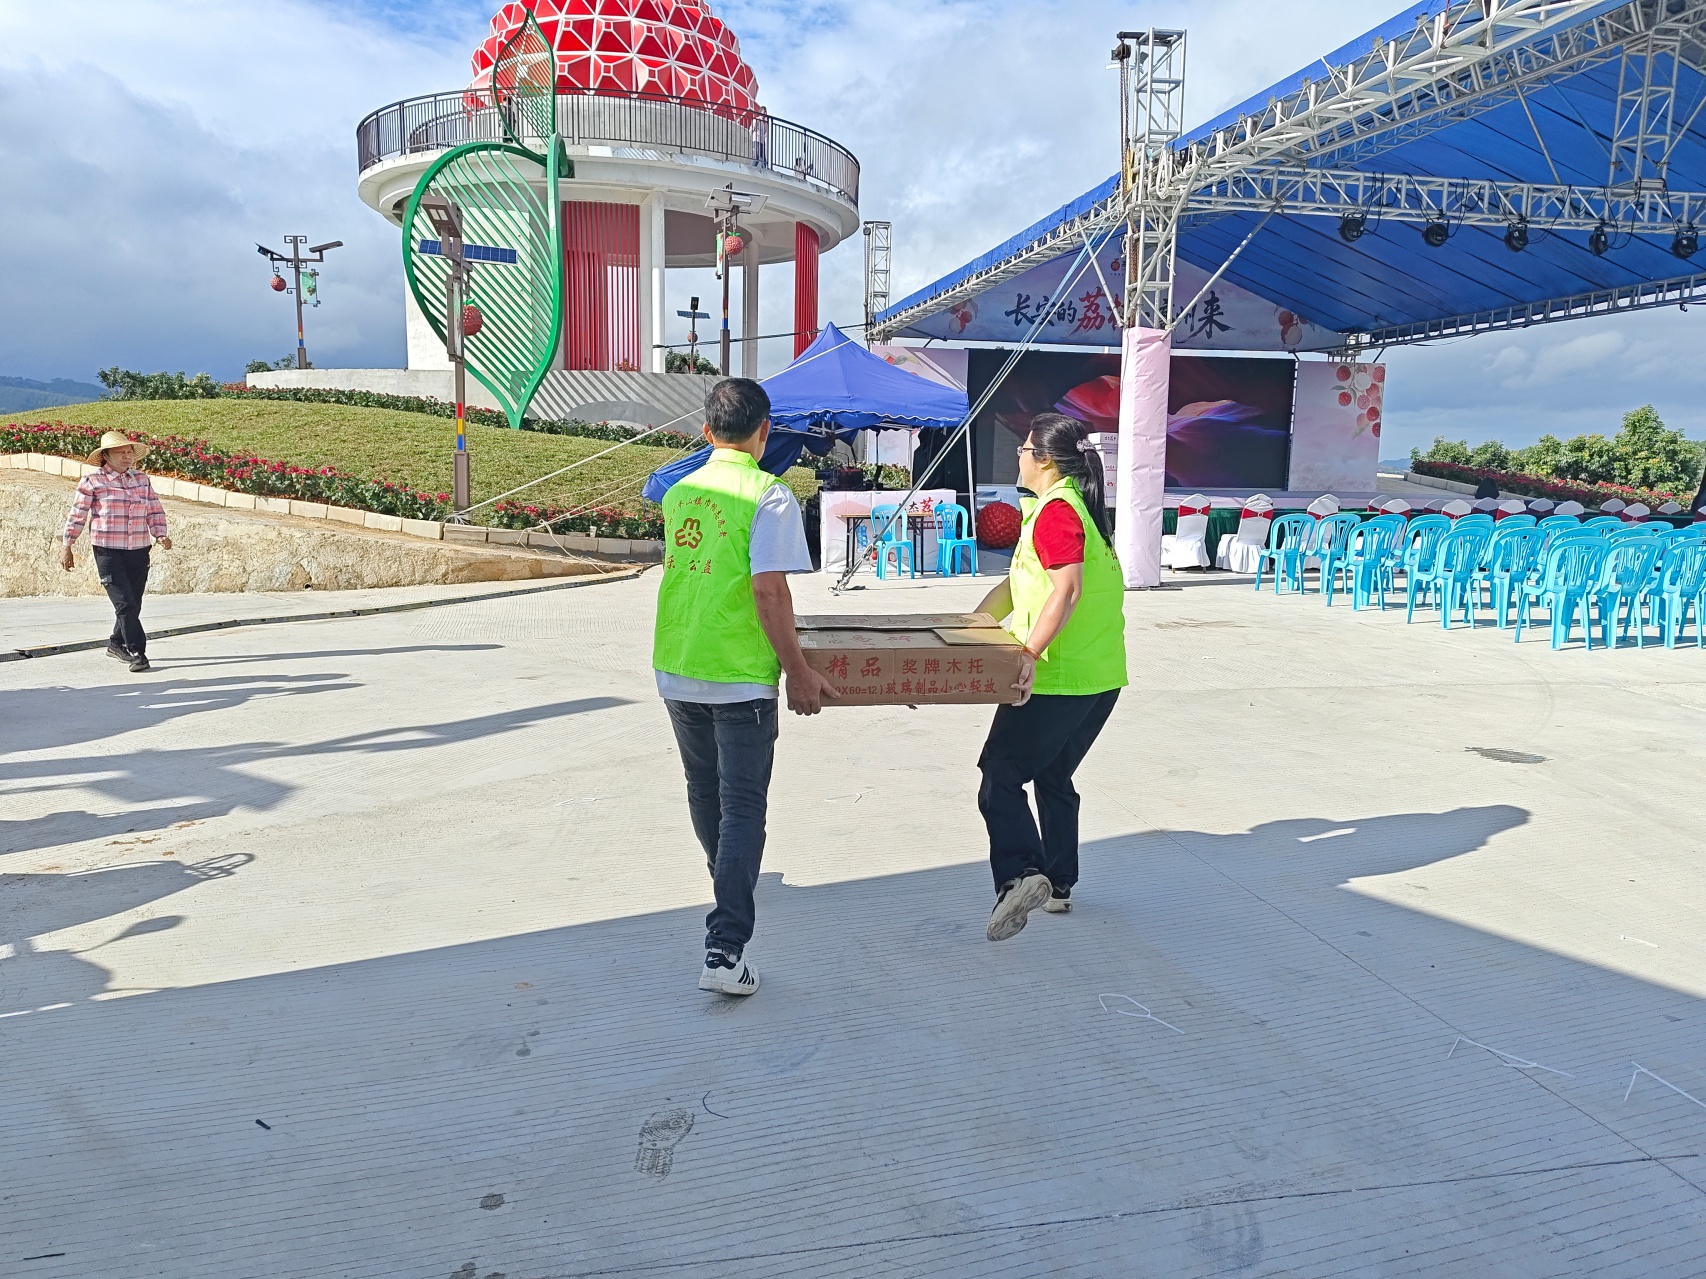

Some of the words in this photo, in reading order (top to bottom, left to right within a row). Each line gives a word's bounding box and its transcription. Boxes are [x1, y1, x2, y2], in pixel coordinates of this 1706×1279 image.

[824, 654, 882, 681] 精品
[902, 657, 984, 676] 奖牌木托
